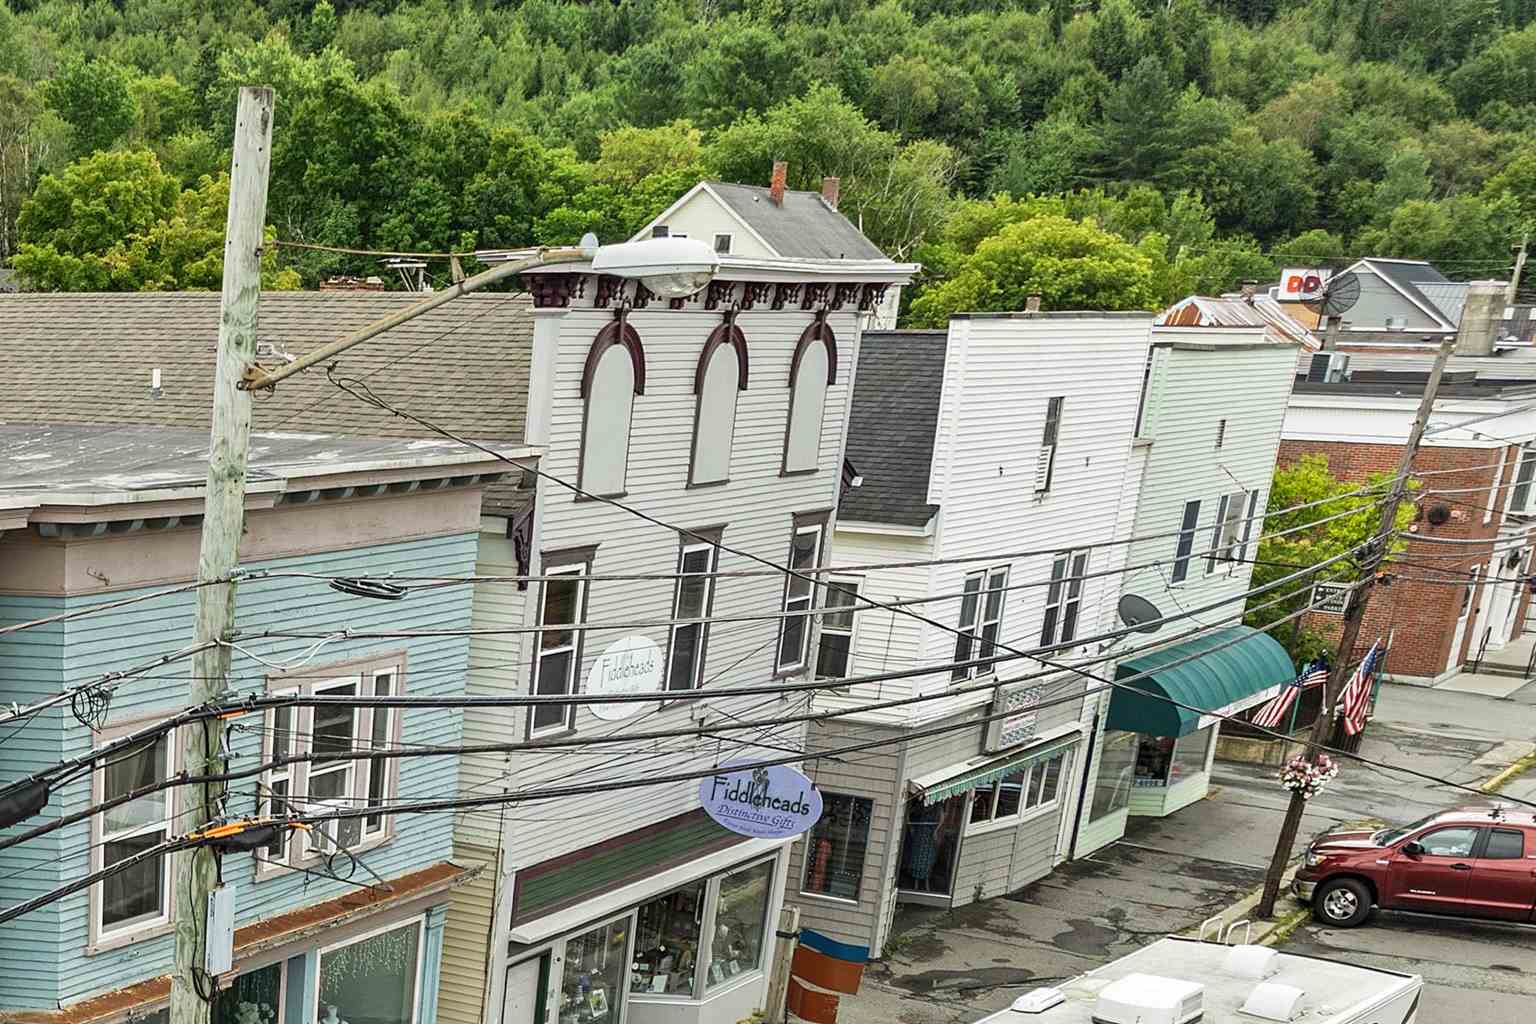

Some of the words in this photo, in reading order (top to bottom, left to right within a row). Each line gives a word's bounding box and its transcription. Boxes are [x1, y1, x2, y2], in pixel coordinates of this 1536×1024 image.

[711, 776, 810, 815] Fiddleheads
[718, 804, 770, 822] Distinctive
[771, 814, 795, 829] Gifts
